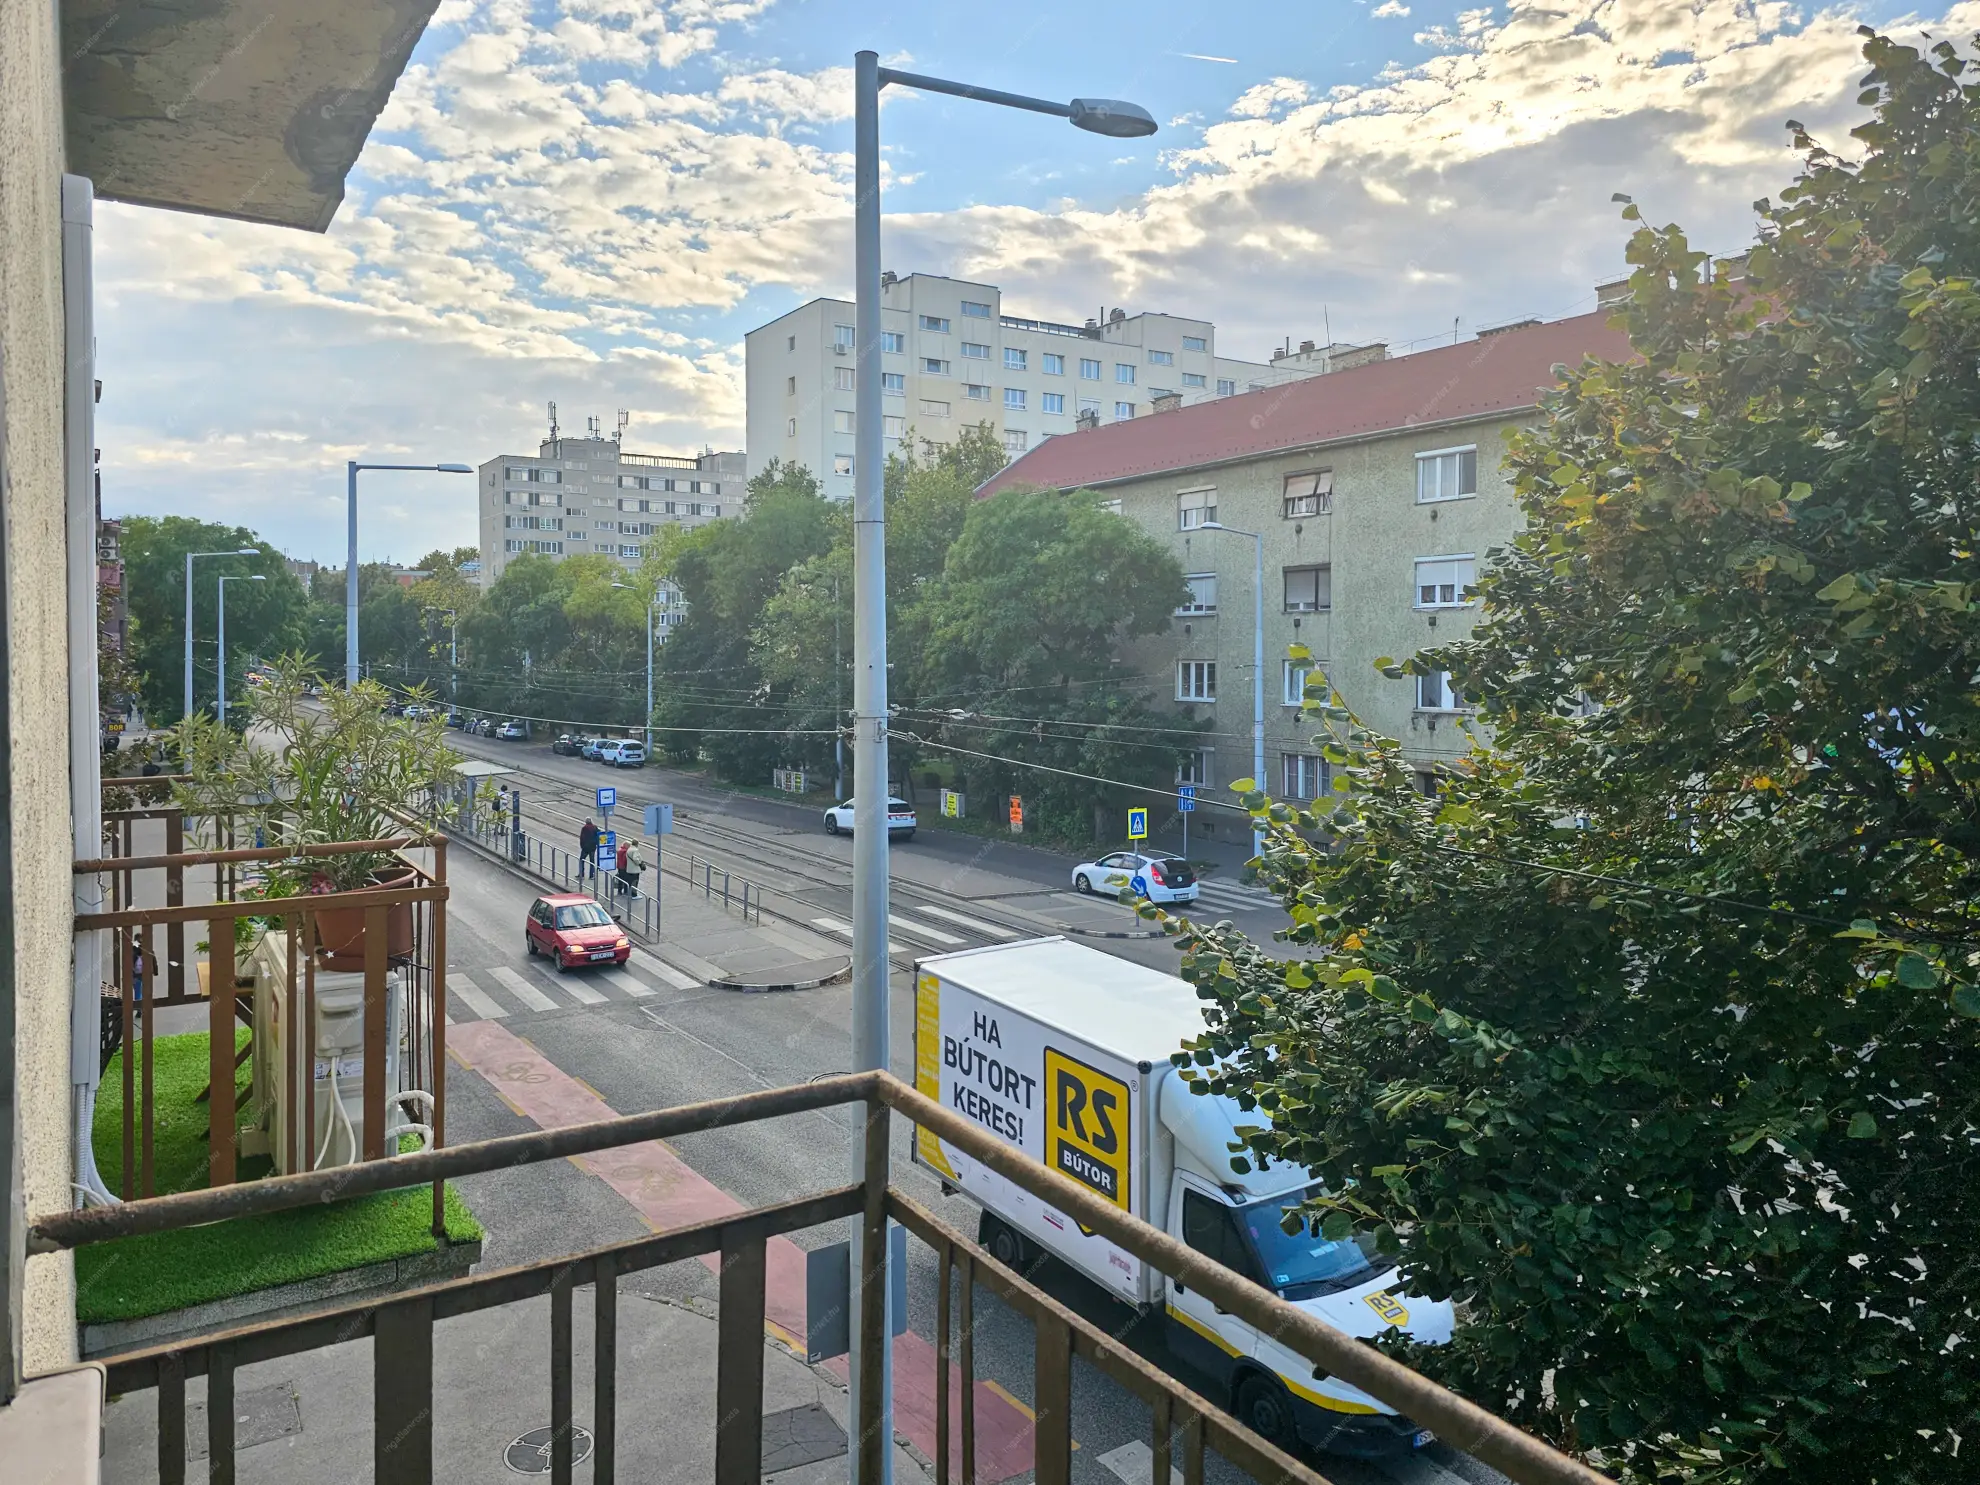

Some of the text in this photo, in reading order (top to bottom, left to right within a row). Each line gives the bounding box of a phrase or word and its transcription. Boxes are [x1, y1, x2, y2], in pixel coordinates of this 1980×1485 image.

[973, 1010, 1002, 1049] HA
[944, 1034, 1036, 1110] BÚTORT
[953, 1081, 1024, 1145] KERES!
[1057, 1068, 1118, 1155] RS
[1063, 1149, 1111, 1190] BÚTOR
[1370, 1294, 1395, 1311] RS
